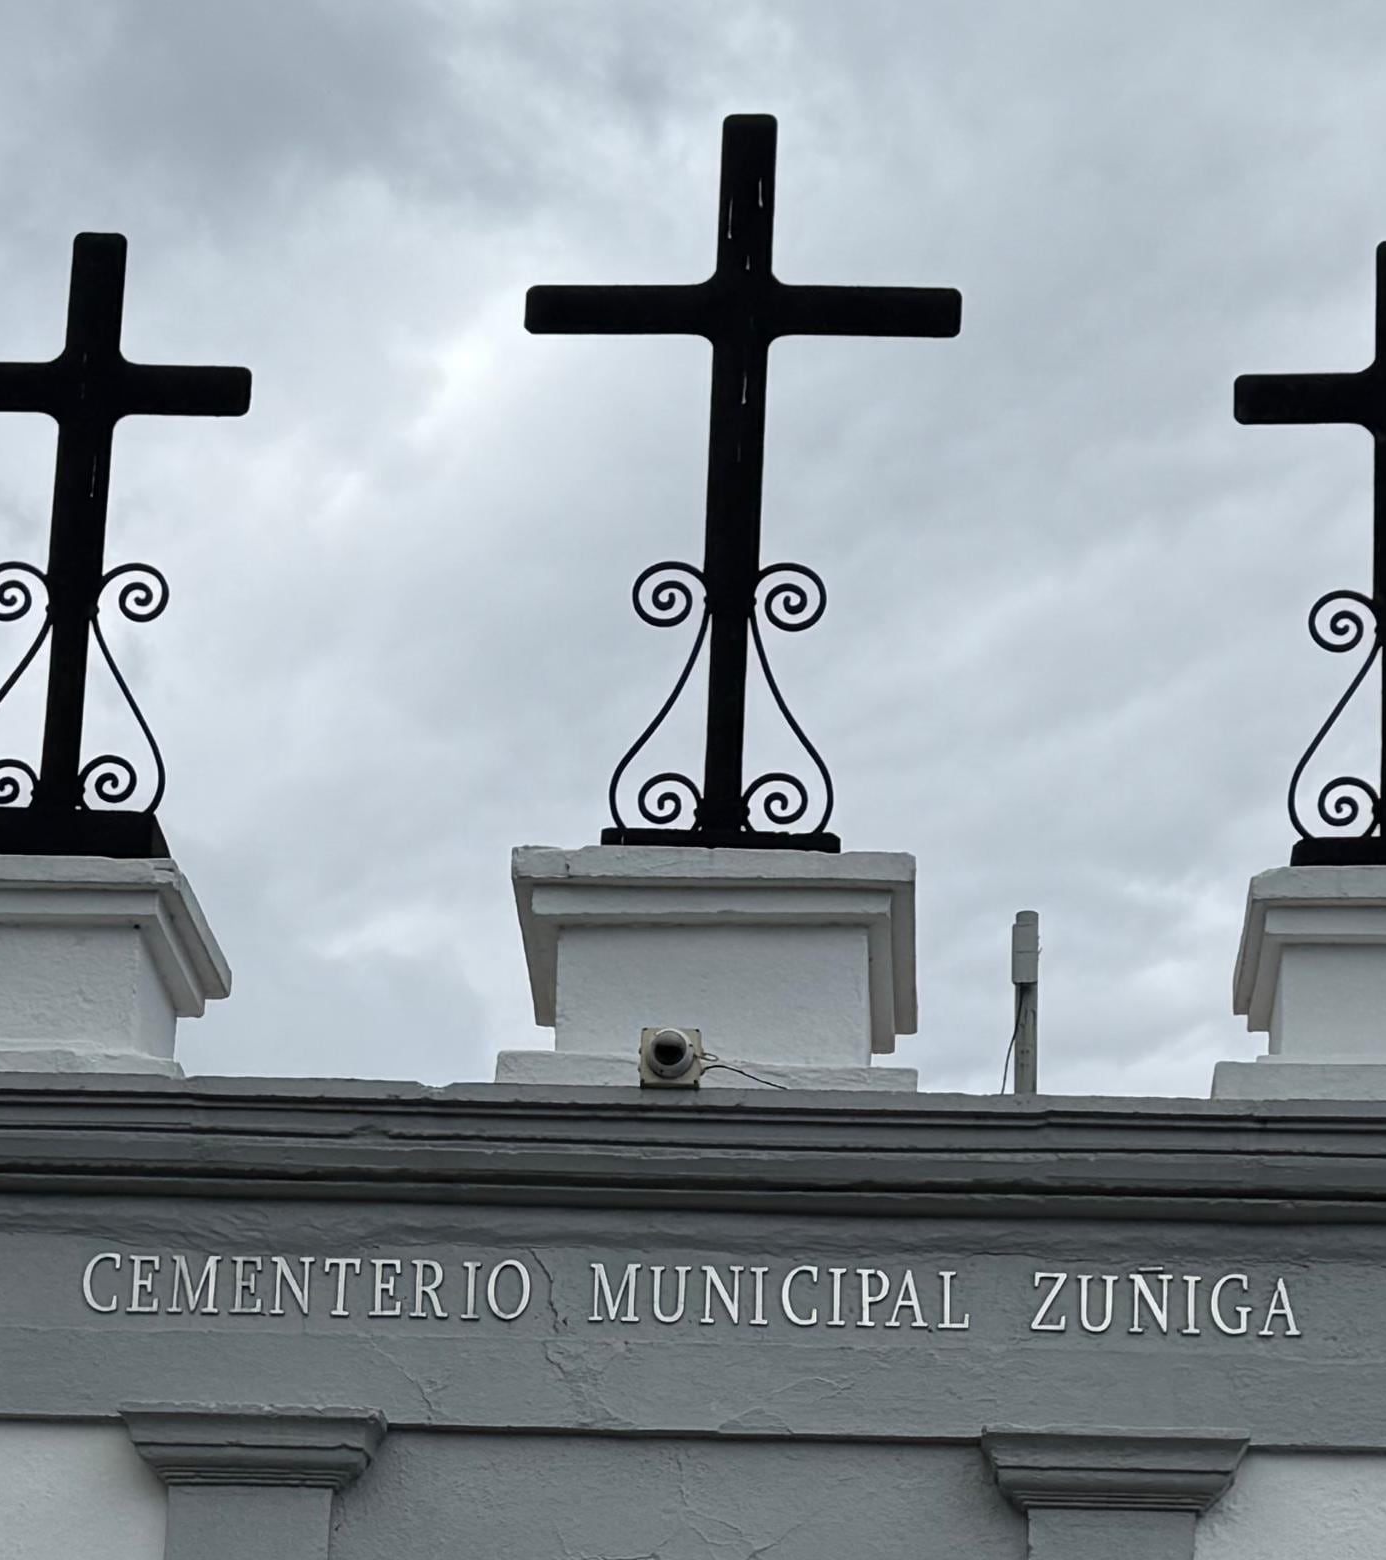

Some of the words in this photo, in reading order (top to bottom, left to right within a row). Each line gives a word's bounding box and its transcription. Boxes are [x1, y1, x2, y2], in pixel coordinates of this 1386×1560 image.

[81, 1252, 532, 1321] CEMENTERIO
[588, 1262, 971, 1330] MUNICIPAL
[1030, 1266, 1303, 1337] ZUÑIGA
